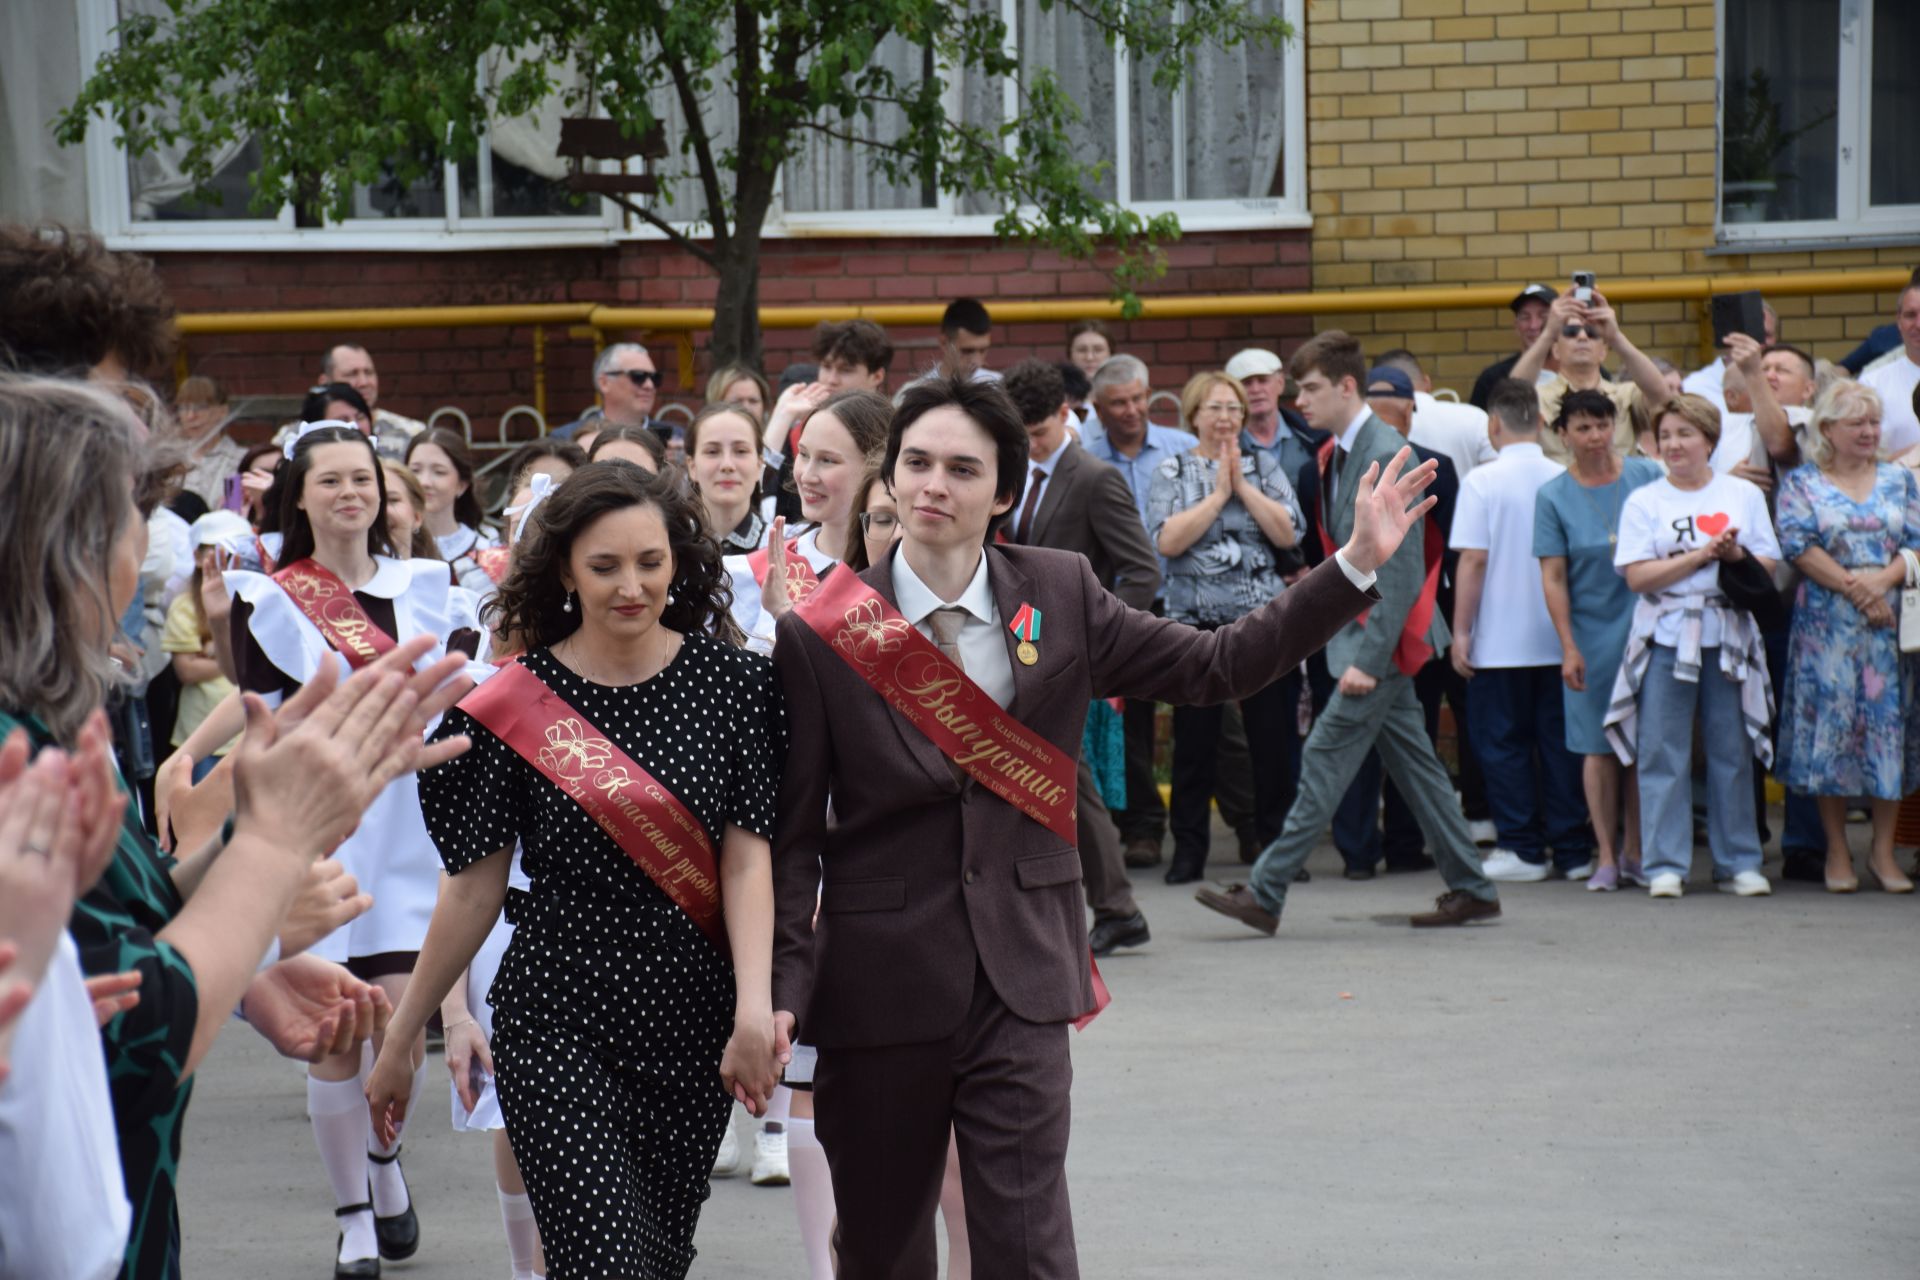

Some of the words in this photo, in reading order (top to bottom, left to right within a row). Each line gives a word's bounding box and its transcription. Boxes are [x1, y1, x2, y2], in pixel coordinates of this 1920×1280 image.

[1672, 515, 1696, 543] Я
[895, 651, 1066, 807] Выпускник
[570, 785, 586, 799] 11
[596, 812, 623, 841] класс
[593, 766, 682, 862] Классный
